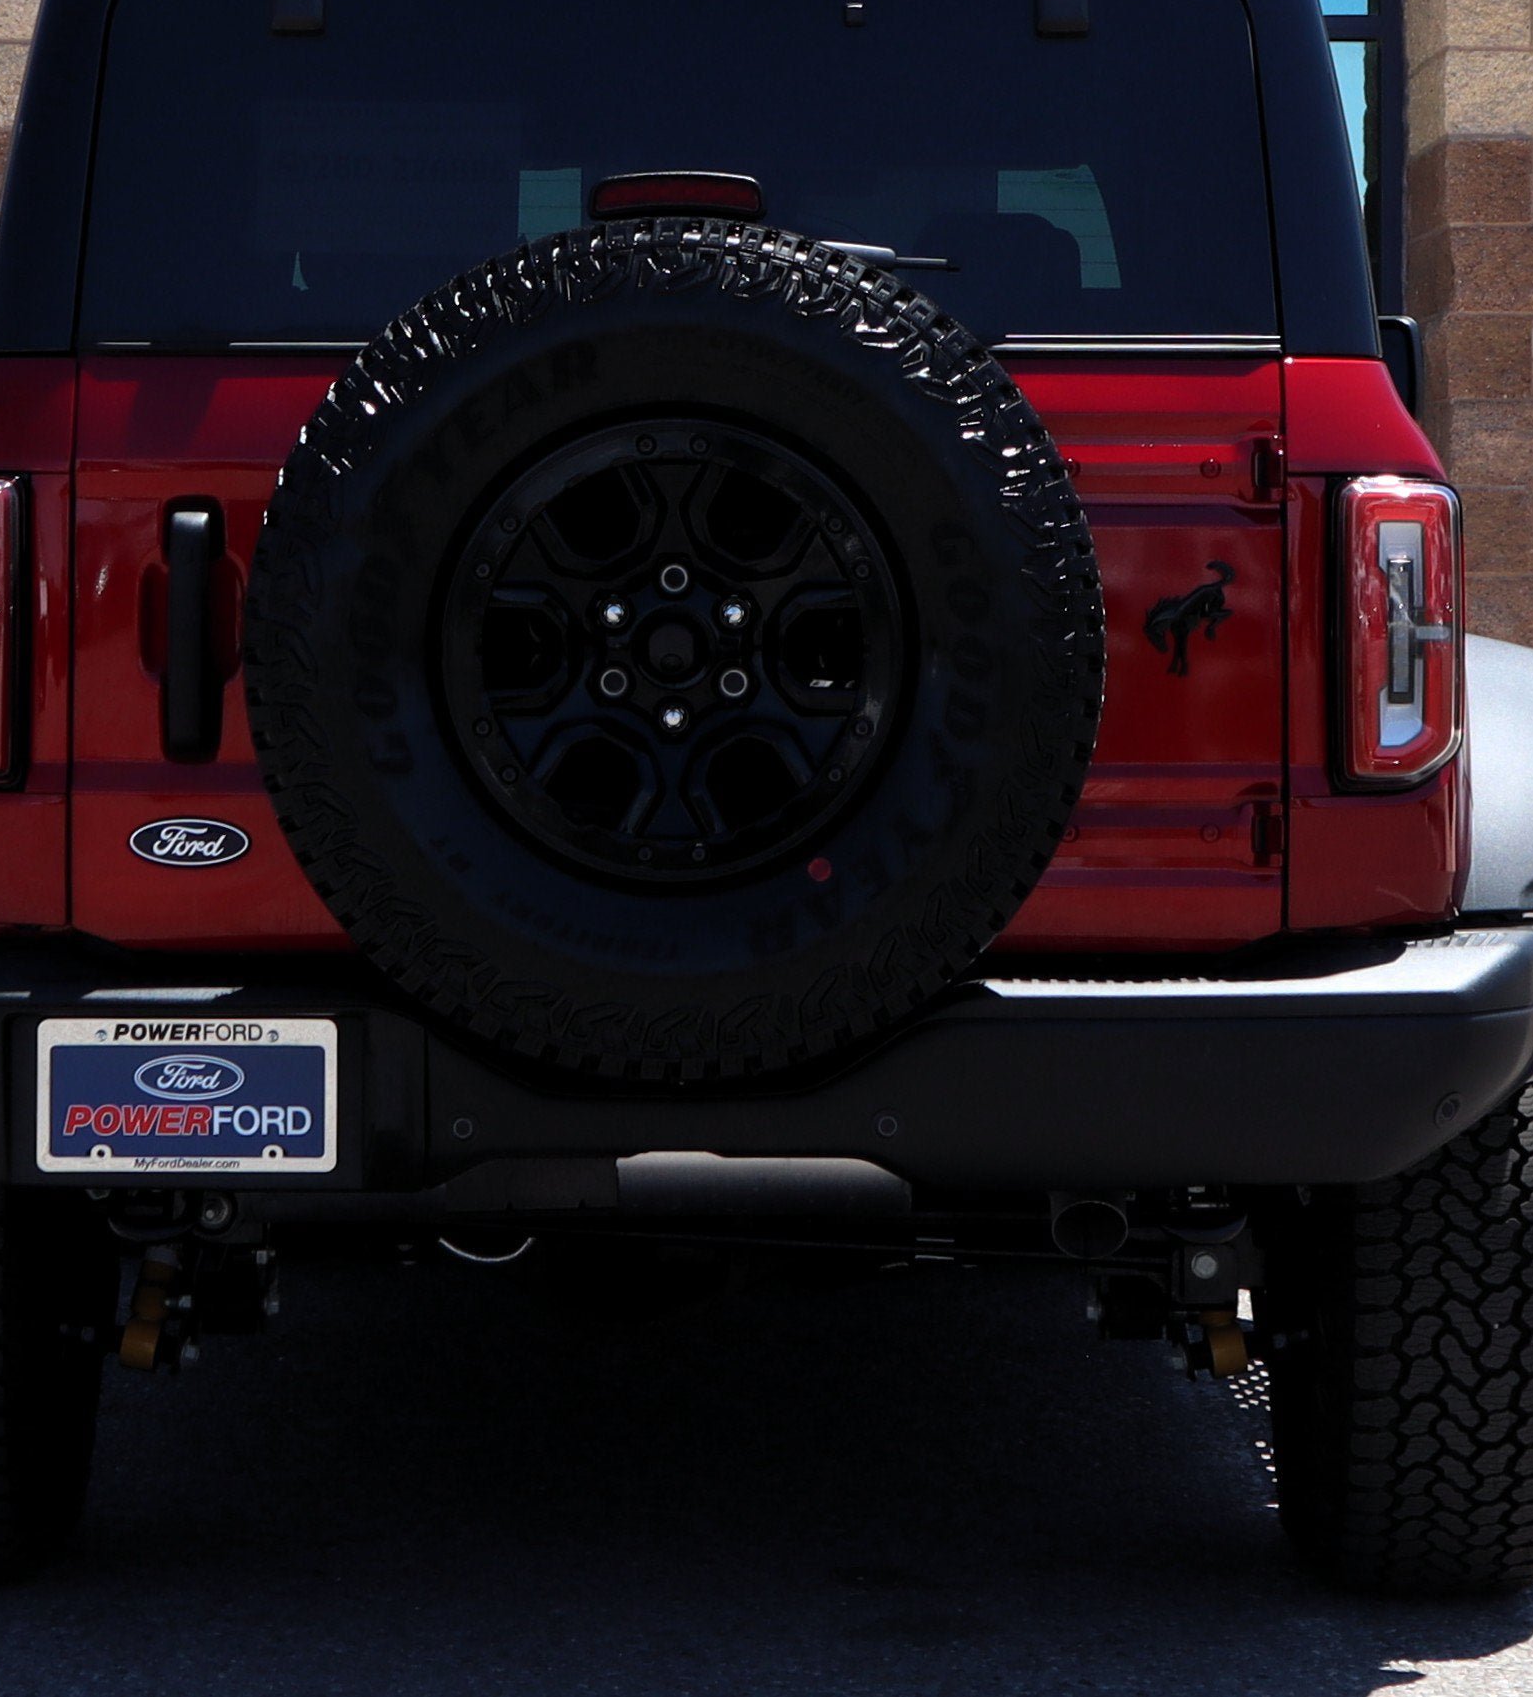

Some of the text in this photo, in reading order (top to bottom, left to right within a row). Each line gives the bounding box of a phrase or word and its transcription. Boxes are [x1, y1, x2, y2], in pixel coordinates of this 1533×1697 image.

[152, 825, 226, 856] Ford
[113, 1023, 263, 1042] POWERFORD
[156, 1062, 221, 1090] Ford
[63, 1104, 312, 1136] POWERFORD
[133, 1157, 240, 1171] MyFordDealer.com
